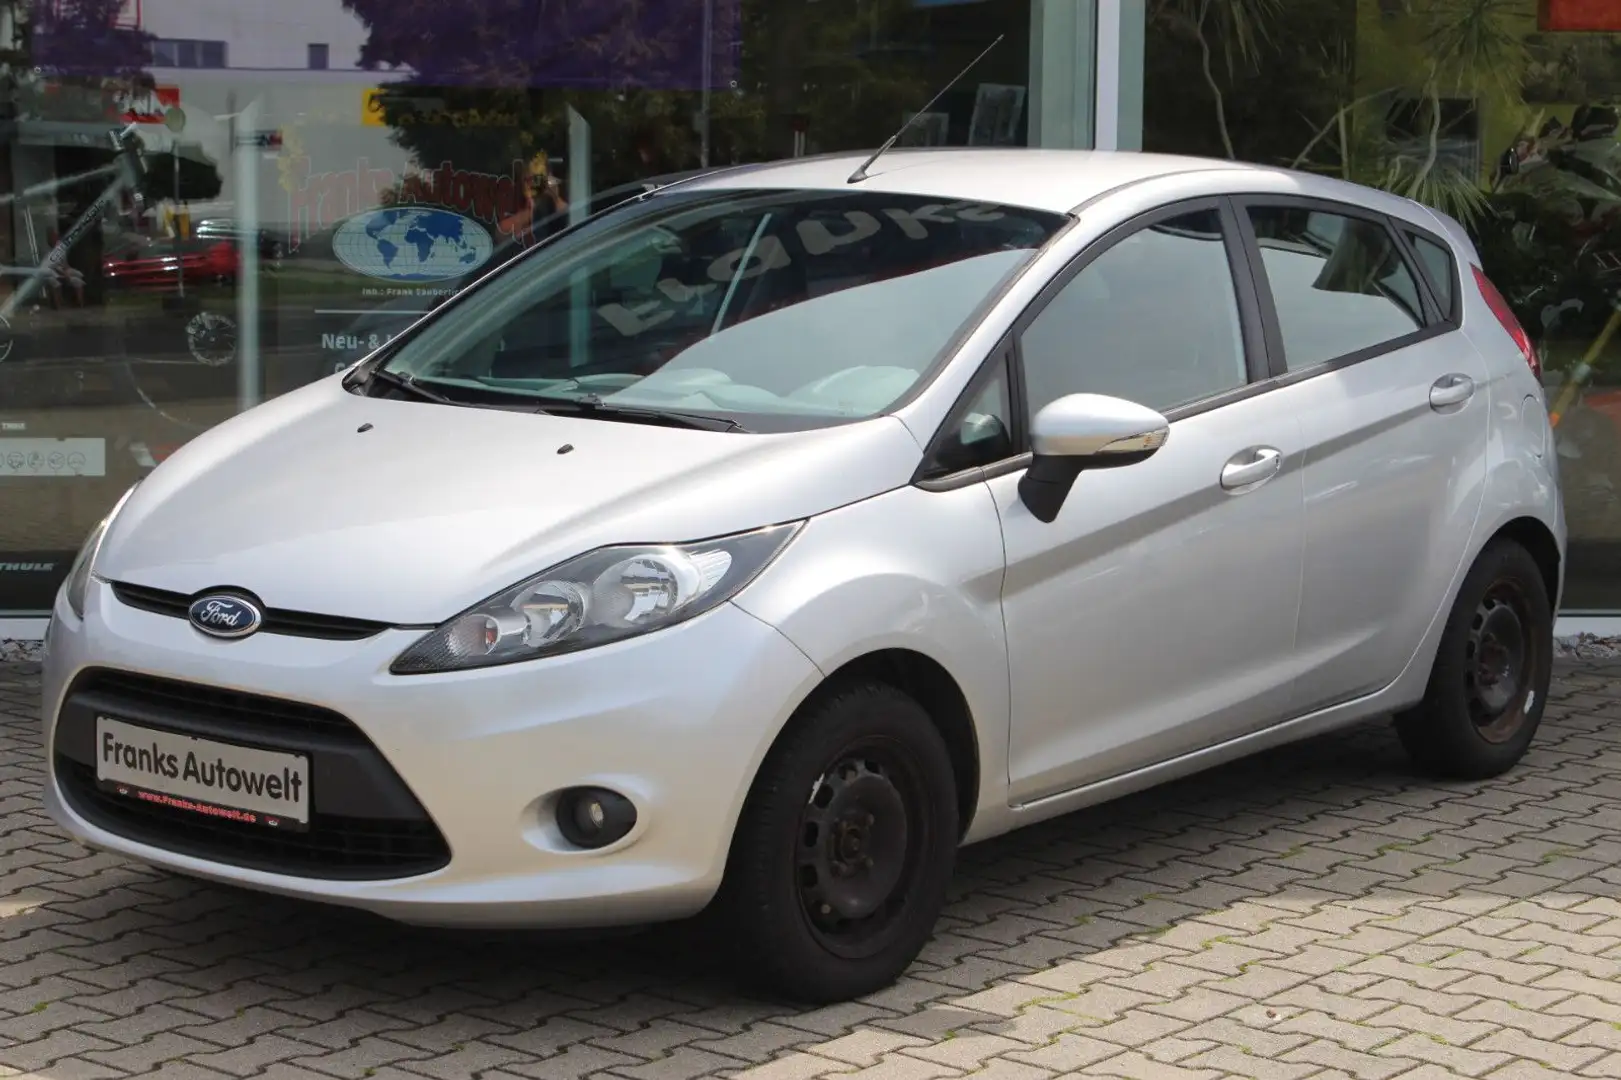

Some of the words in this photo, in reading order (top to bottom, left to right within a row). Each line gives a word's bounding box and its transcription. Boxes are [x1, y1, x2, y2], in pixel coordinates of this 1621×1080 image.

[386, 288, 413, 296] Frank
[321, 333, 365, 349] Neu-
[367, 333, 380, 349] &
[201, 600, 242, 626] Ford
[103, 732, 179, 779] Franks
[183, 751, 302, 802] Autowelt
